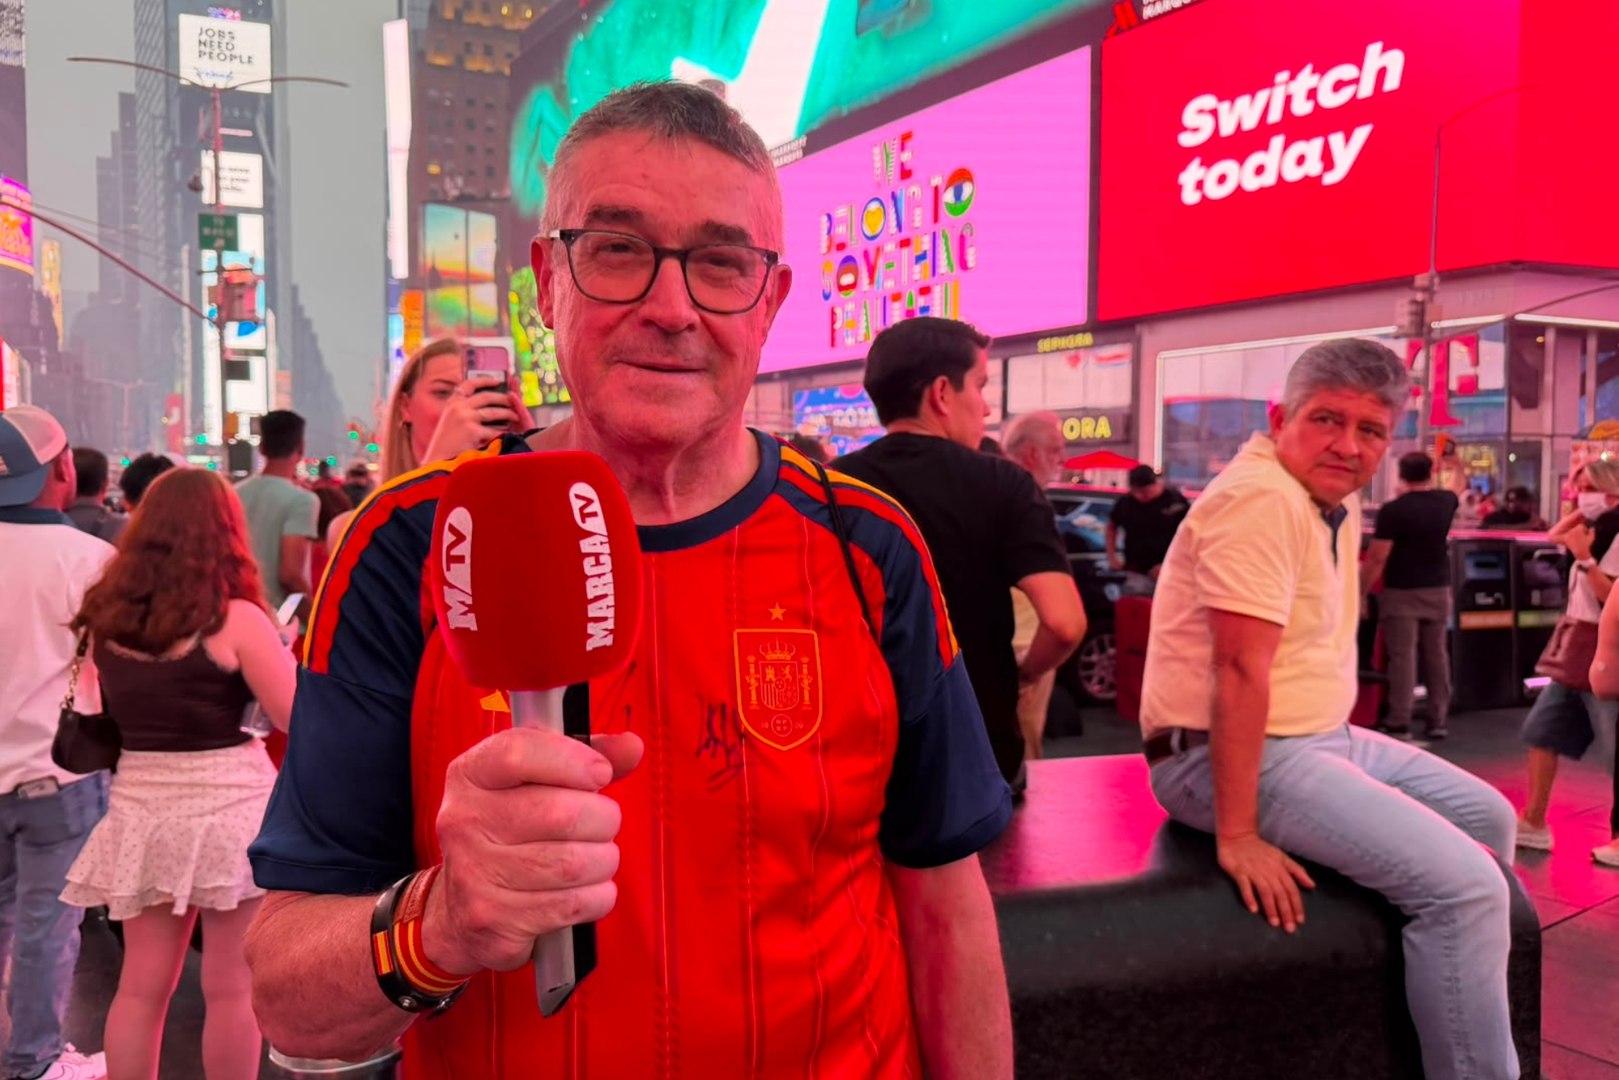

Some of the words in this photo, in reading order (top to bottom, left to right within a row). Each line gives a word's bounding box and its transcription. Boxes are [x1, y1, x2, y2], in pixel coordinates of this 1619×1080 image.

[199, 27, 235, 40] JOBS
[199, 39, 235, 51] NEED
[199, 50, 254, 64] PEOPLE
[1177, 40, 1405, 148] Switch
[872, 131, 913, 187] WE
[1178, 123, 1374, 206] today
[820, 185, 922, 255] BELONG
[930, 168, 975, 224] TO
[822, 222, 976, 301] SOMETHING
[1037, 332, 1093, 353] SEPHORA
[1061, 415, 1112, 440] ORA
